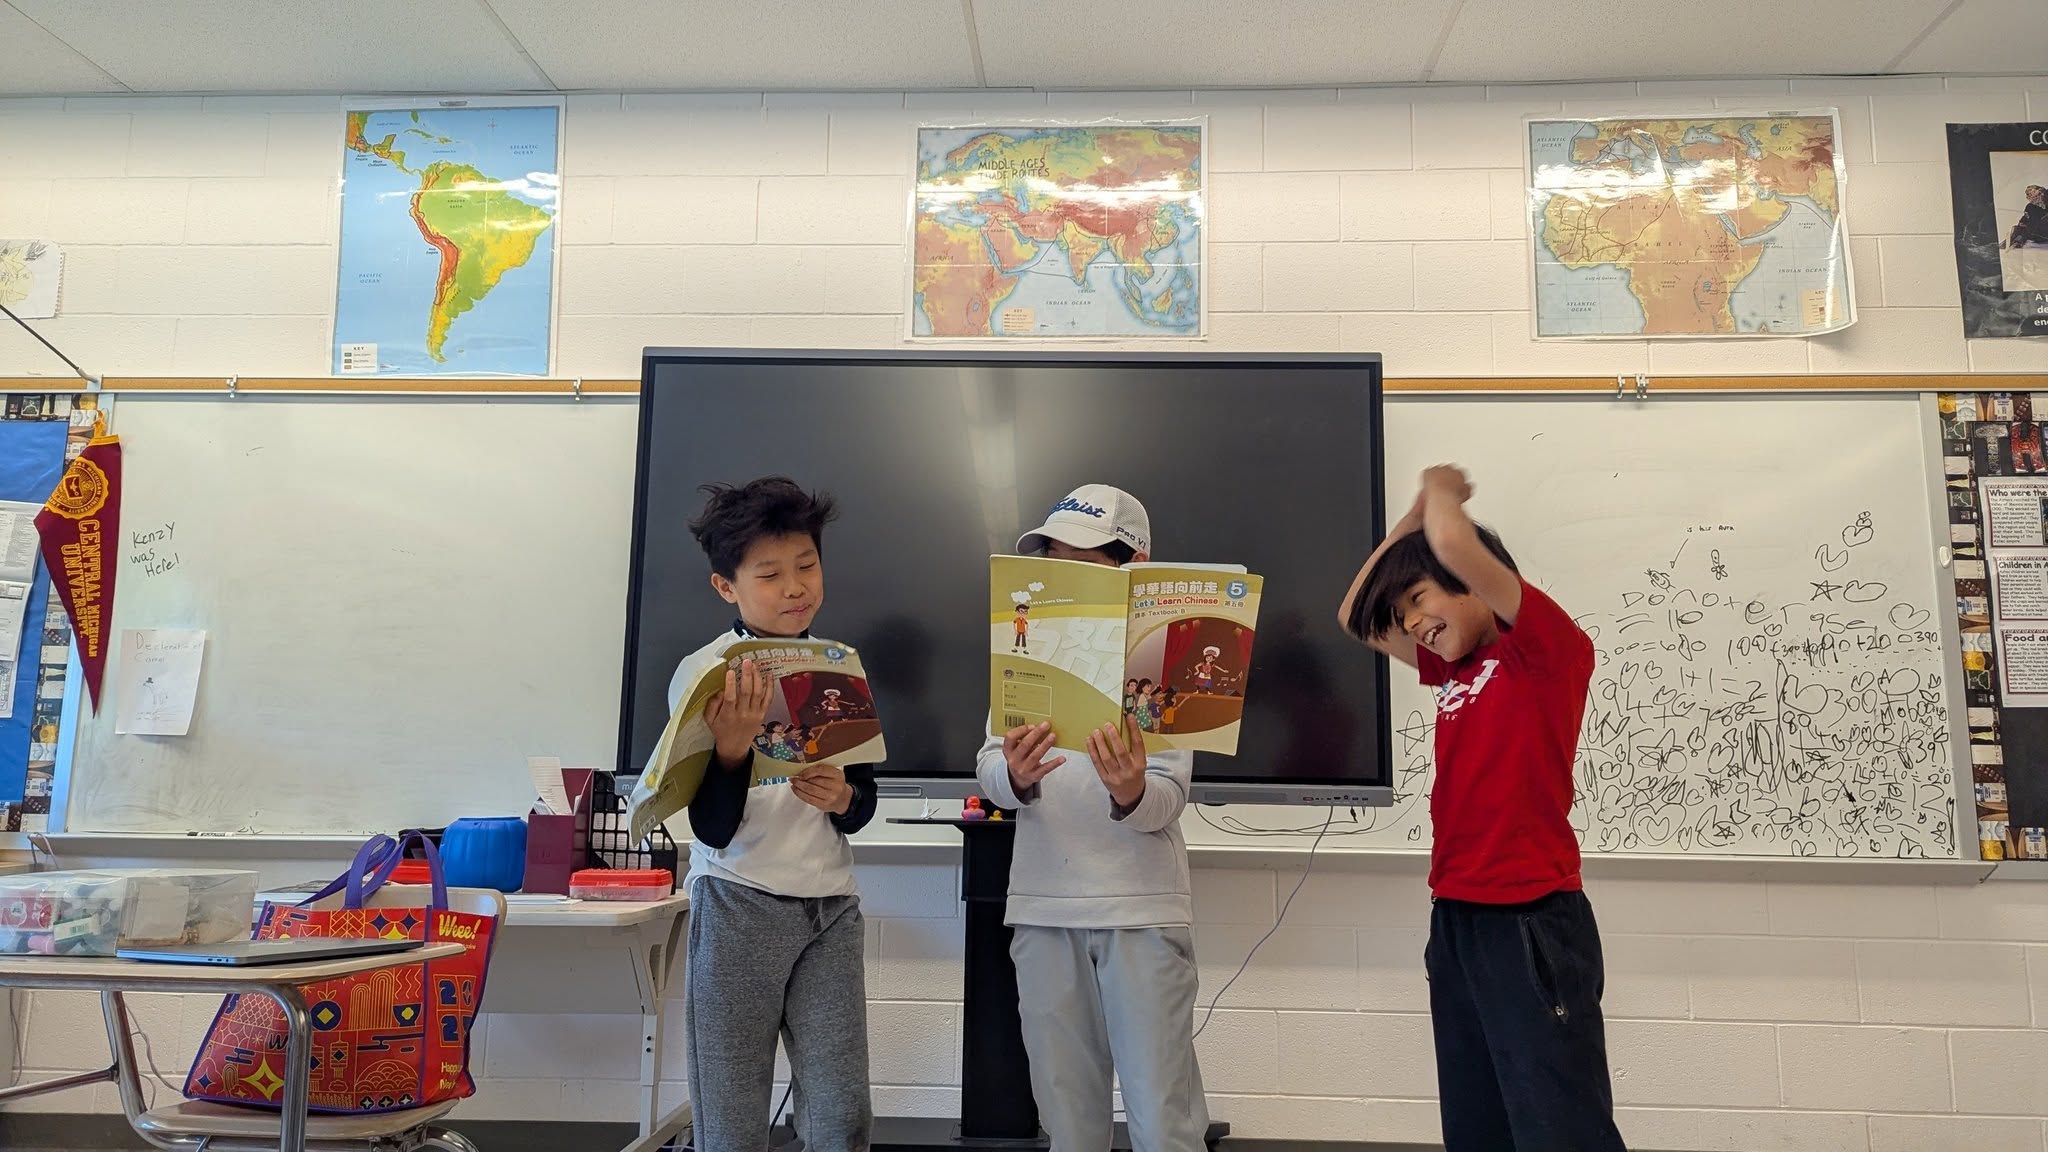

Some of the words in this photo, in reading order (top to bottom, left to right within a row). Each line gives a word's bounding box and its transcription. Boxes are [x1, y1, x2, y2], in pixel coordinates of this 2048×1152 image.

[978, 158, 1015, 170] MIDDLE
[1020, 158, 1046, 168] AGES
[1012, 168, 1050, 179] ROUTES
[2037, 305, 2048, 313] de
[1975, 421, 2048, 475] TH
[78, 519, 100, 601] CENTRAL
[130, 548, 155, 564] was
[61, 542, 89, 636] UNIVERSITY
[1133, 582, 1218, 597] 學華語向前走
[1230, 582, 1243, 595] 5
[1134, 600, 1155, 609] Let's
[1184, 596, 1218, 604] Chinese
[87, 604, 100, 657] MICHIGAN
[439, 914, 481, 940] Weee!
